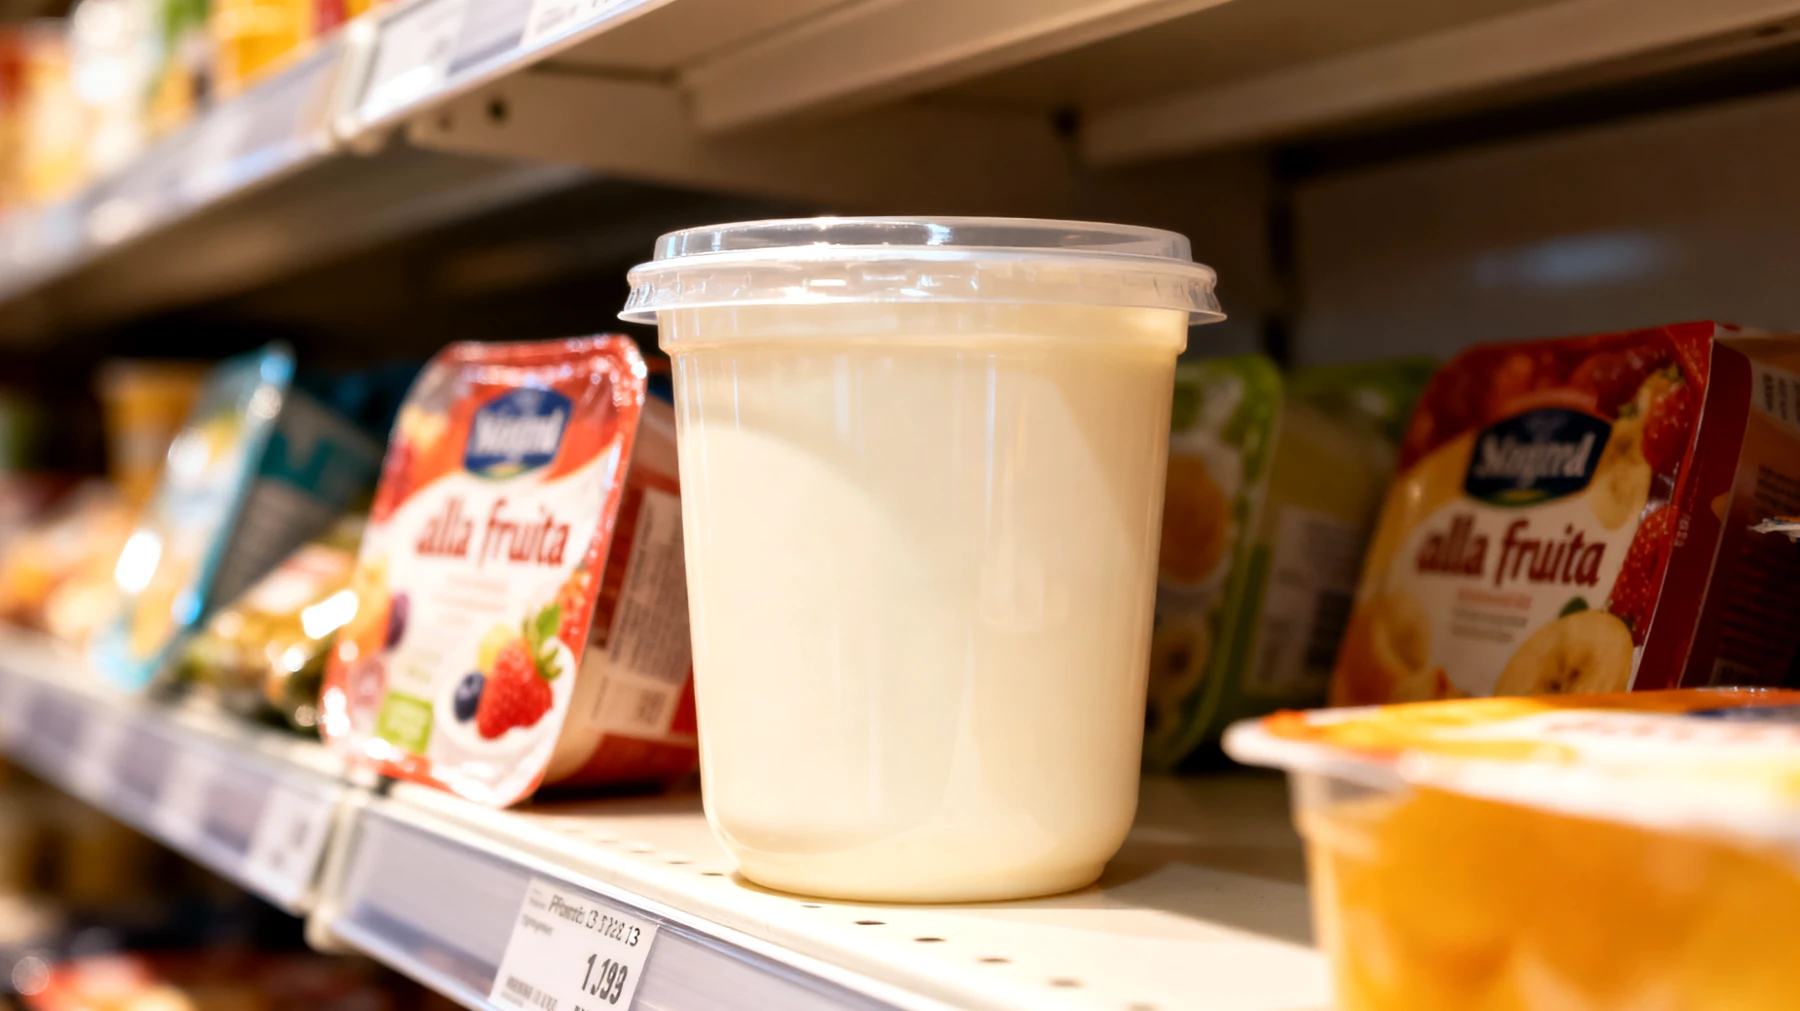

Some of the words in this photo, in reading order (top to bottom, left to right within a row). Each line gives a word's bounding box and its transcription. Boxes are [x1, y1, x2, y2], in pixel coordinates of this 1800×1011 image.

[416, 497, 472, 557] alla
[478, 497, 570, 568] fruita
[1416, 513, 1488, 578] alla
[1494, 516, 1606, 587] fruita
